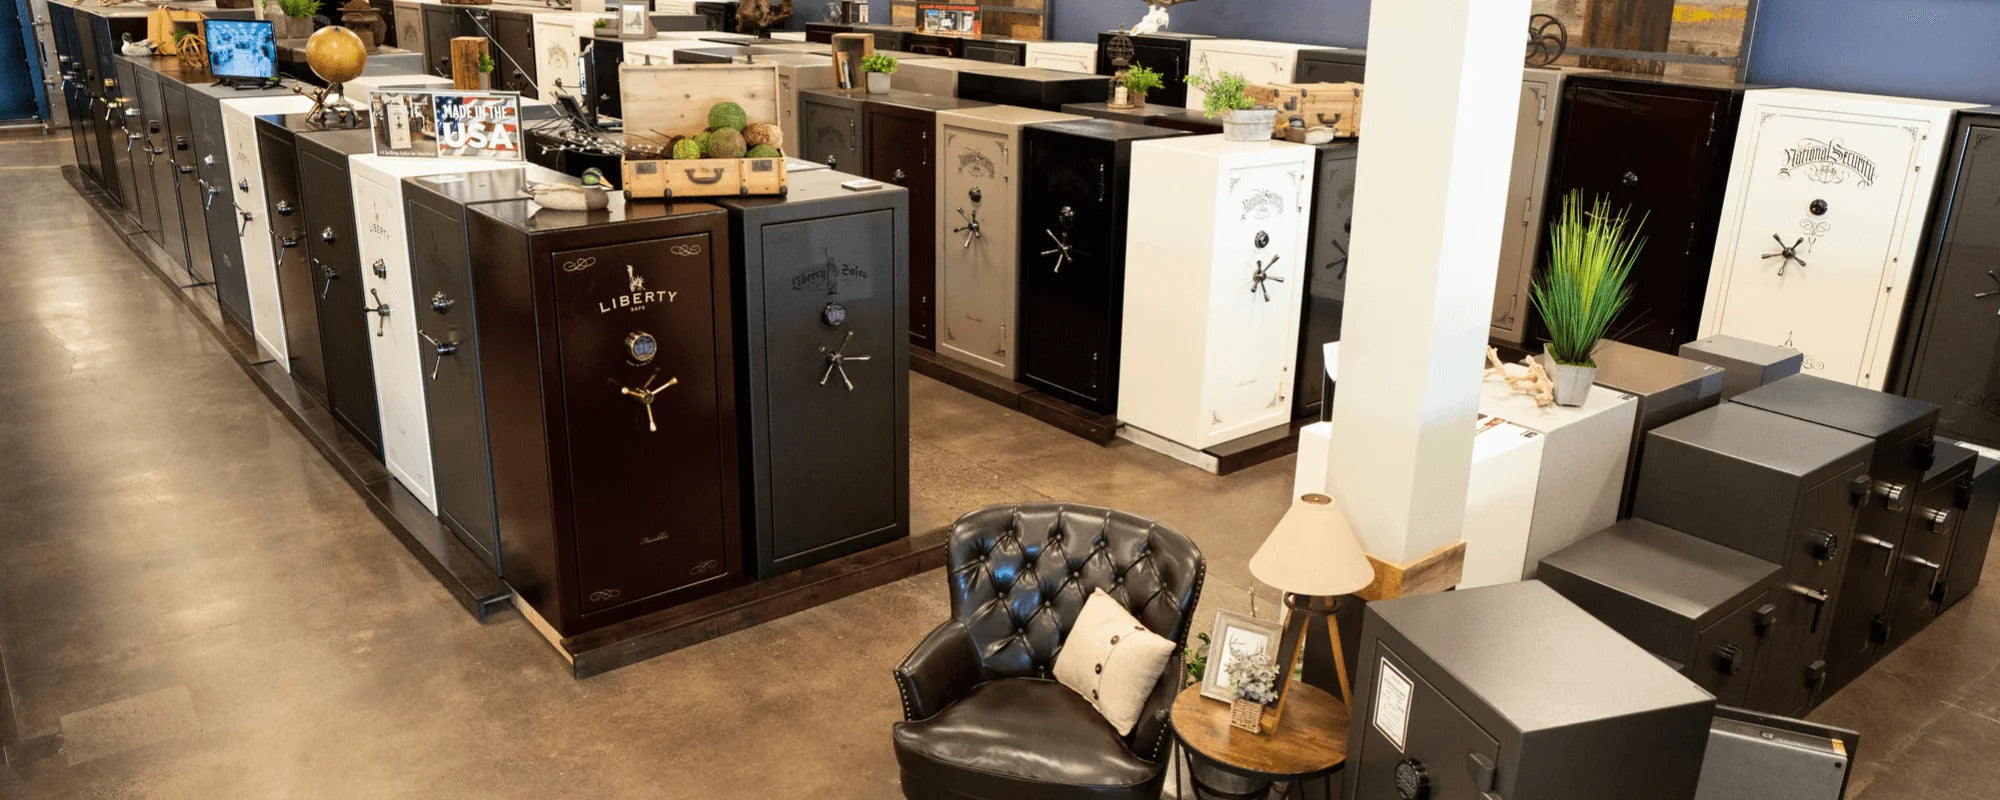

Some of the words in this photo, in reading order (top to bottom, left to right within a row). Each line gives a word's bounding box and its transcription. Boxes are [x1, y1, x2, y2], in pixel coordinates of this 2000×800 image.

[443, 104, 473, 119] MADE
[476, 105, 485, 119] IN
[489, 106, 507, 119] THE
[443, 122, 514, 150] USA
[1784, 140, 1834, 168] National
[1832, 142, 1876, 187] Security
[368, 222, 390, 240] LIBERTY
[599, 290, 678, 314] LIBERTY
